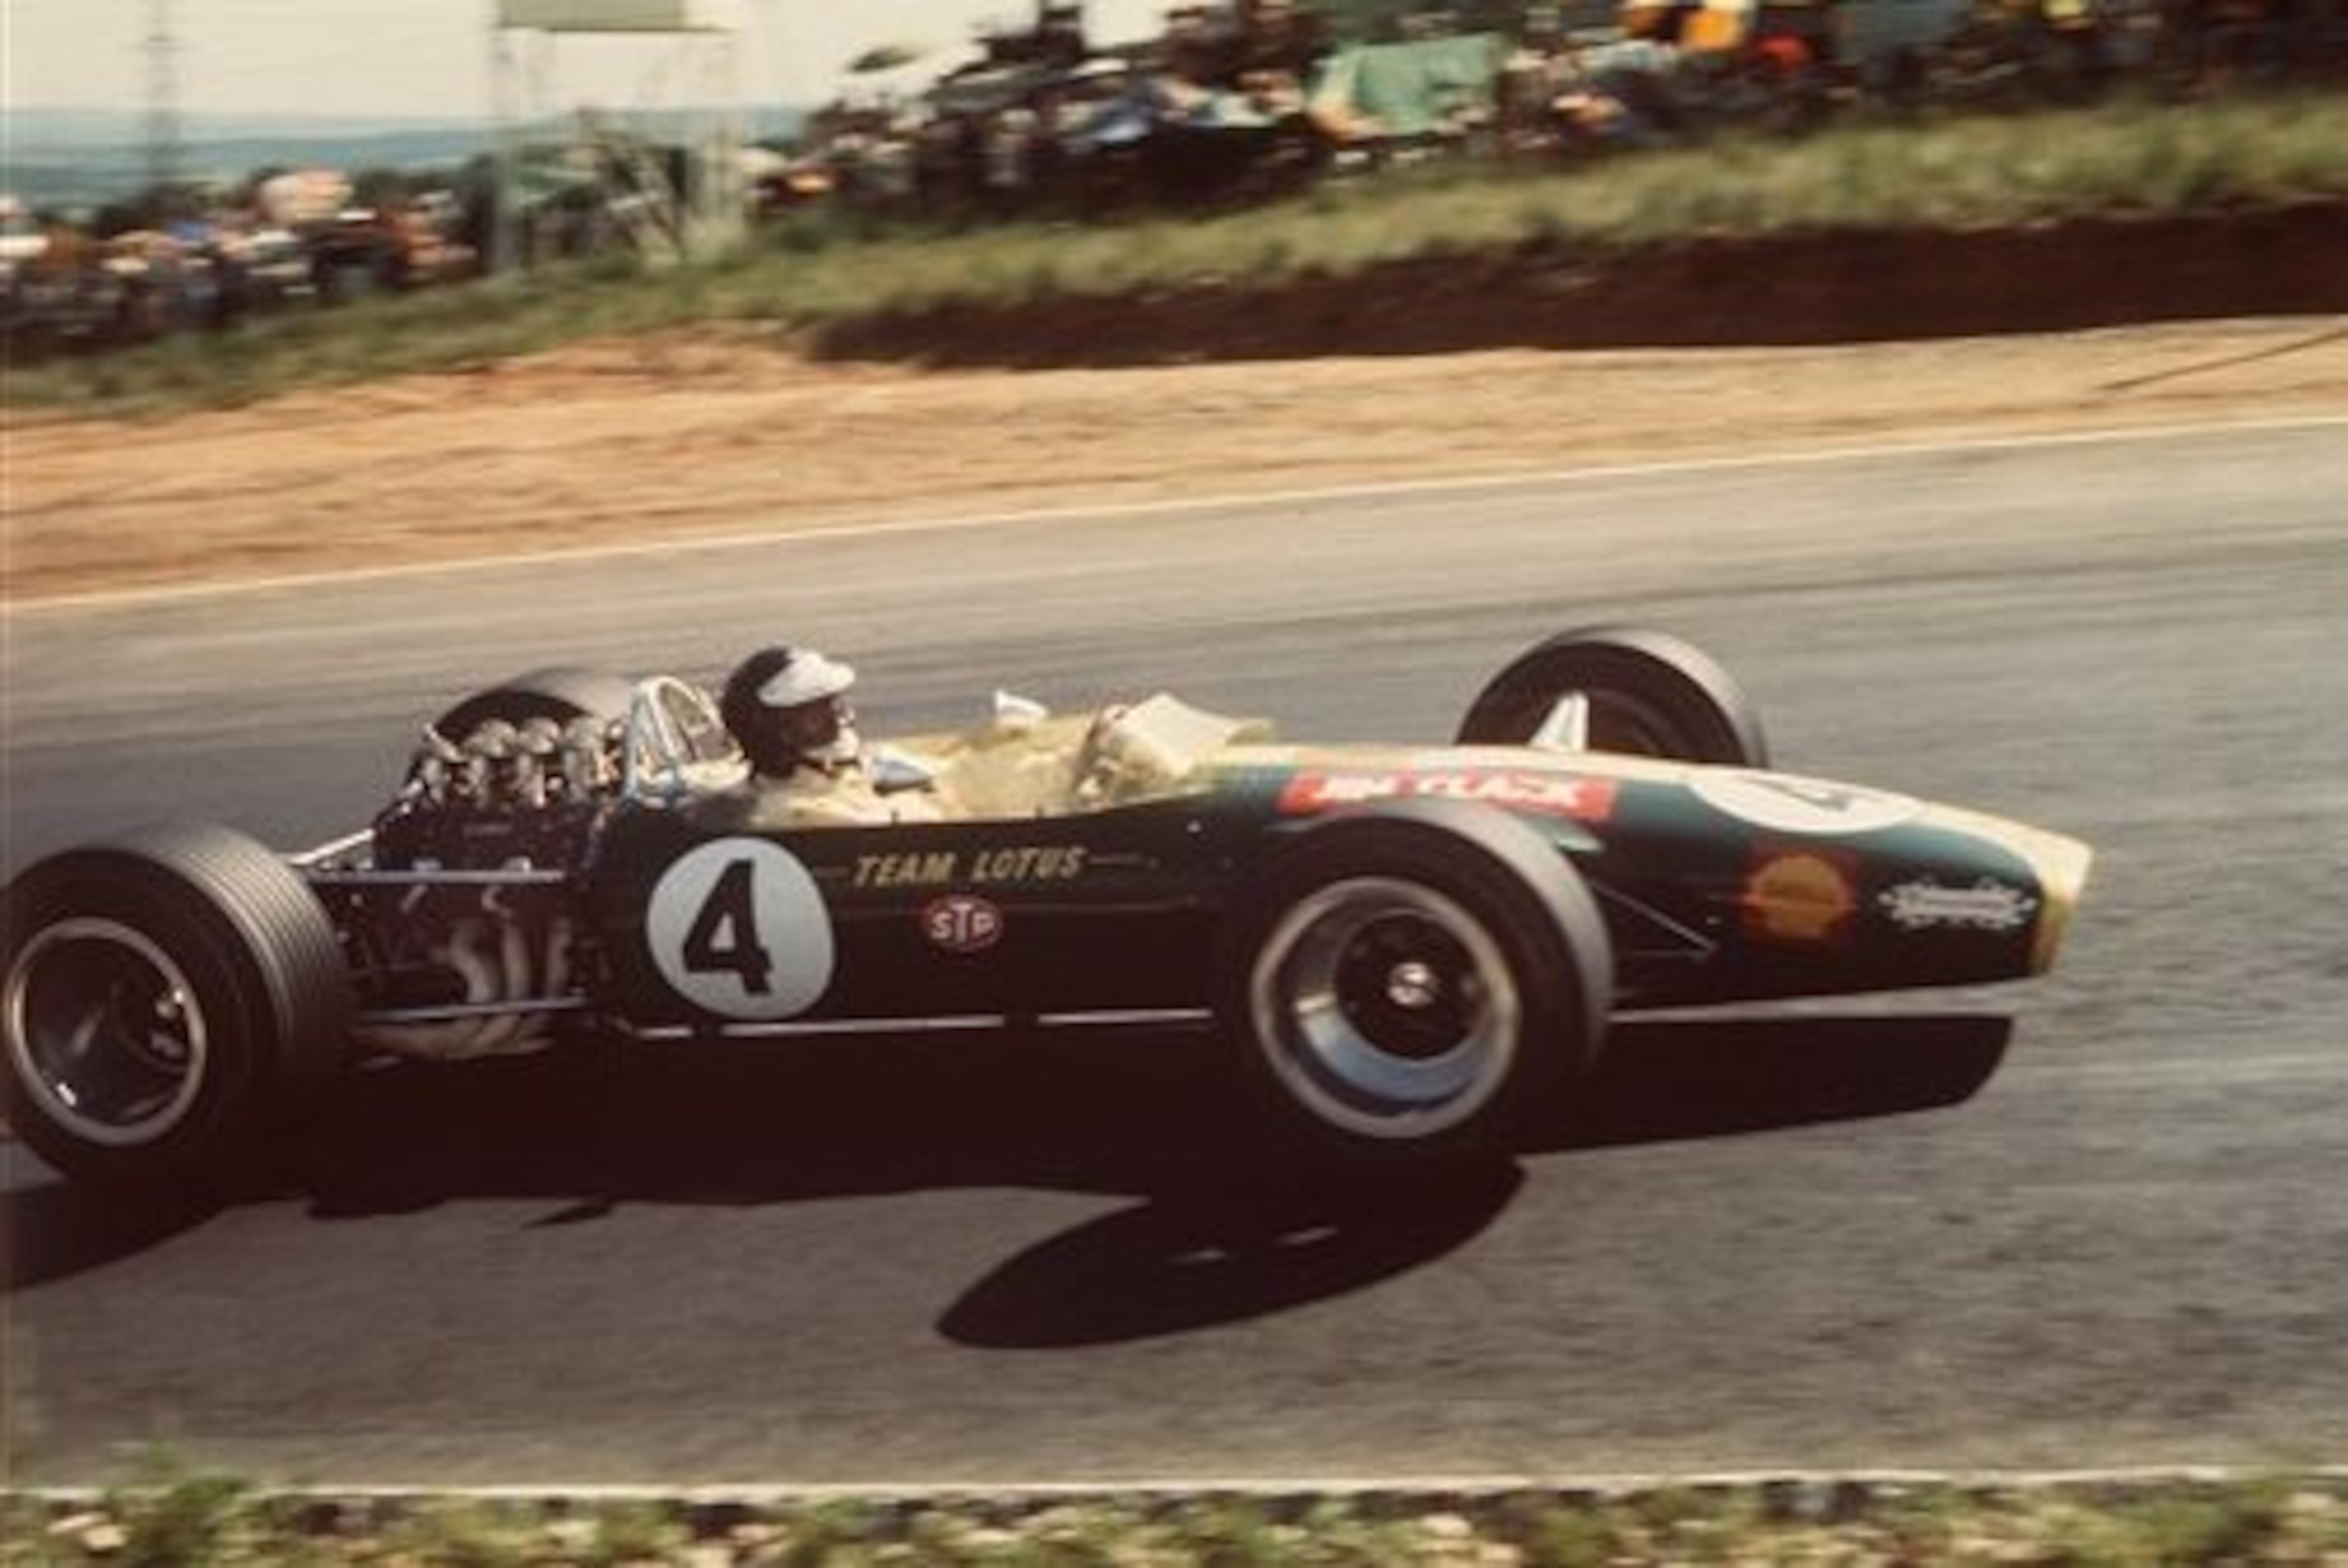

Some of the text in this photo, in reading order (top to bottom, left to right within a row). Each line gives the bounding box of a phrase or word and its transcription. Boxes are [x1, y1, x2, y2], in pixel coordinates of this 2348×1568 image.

[854, 845, 1087, 886] TEAM LOTUS
[682, 858, 773, 995] 4
[930, 902, 996, 943] STP
